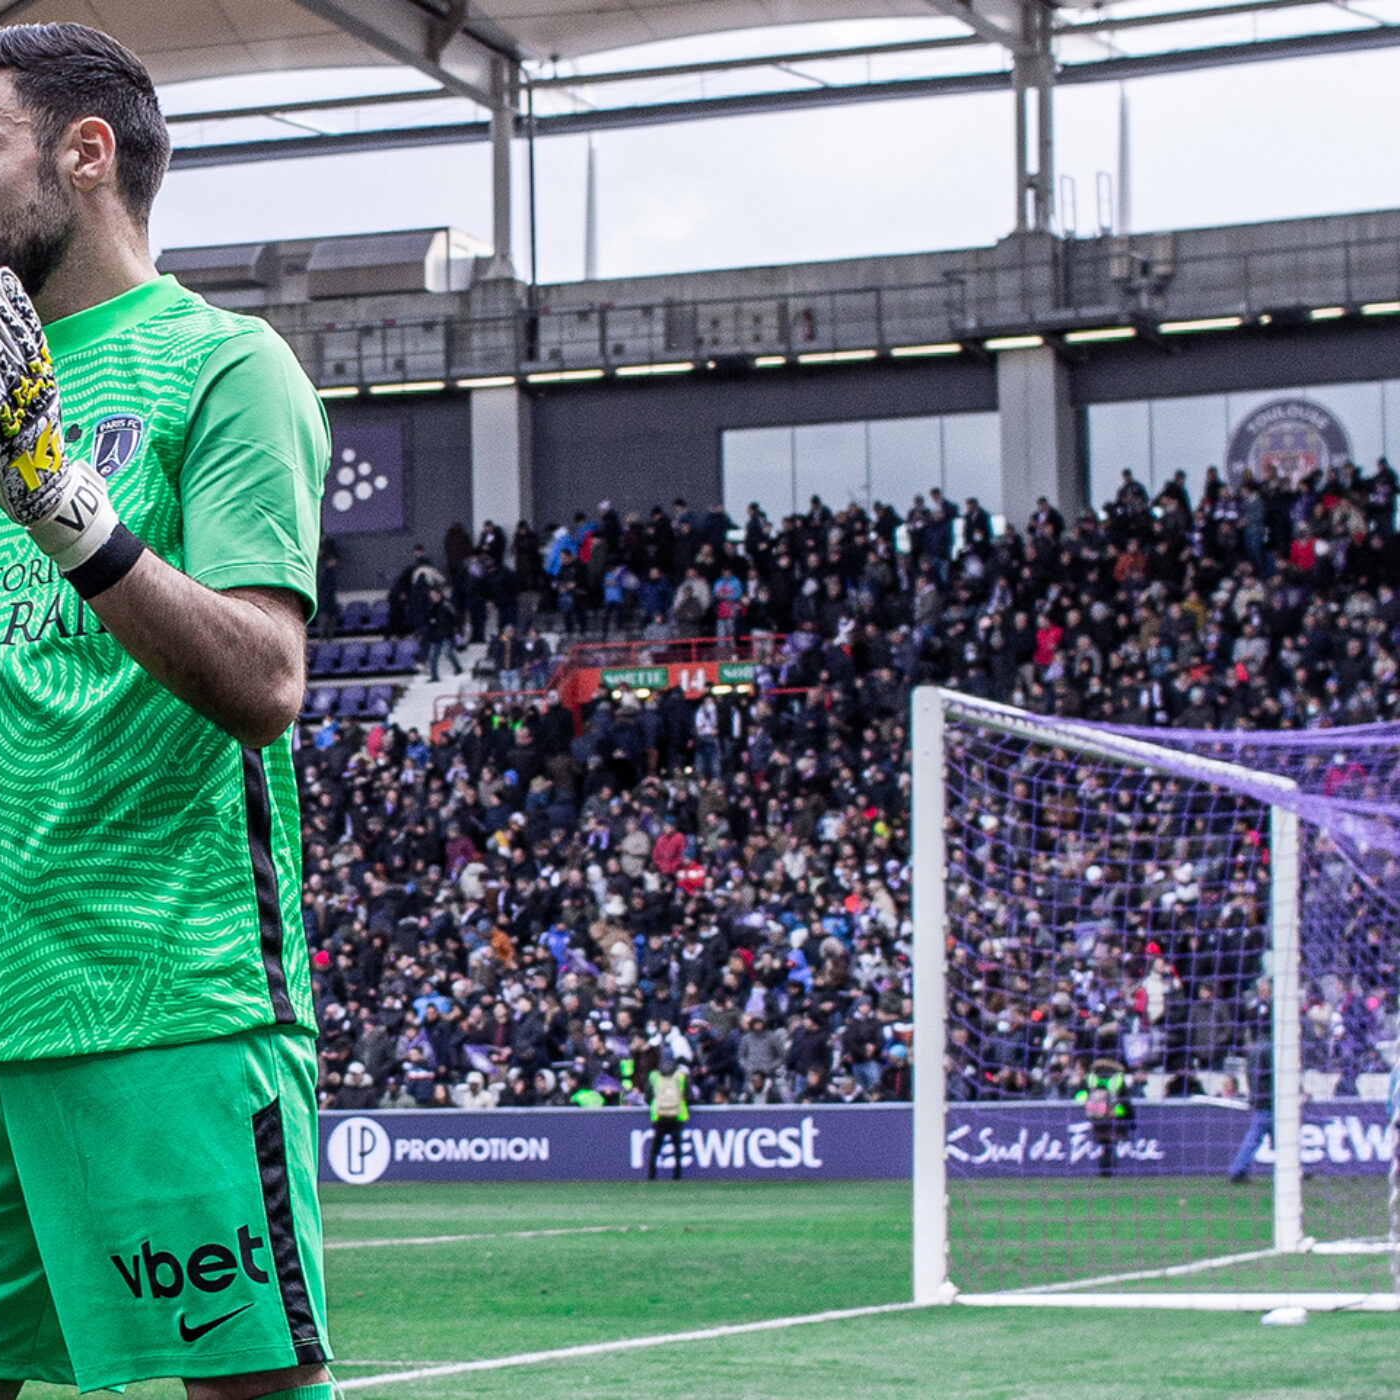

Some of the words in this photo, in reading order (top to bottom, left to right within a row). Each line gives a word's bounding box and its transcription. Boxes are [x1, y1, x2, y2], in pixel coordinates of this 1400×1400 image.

[99, 419, 126, 433] PARIS
[127, 419, 139, 429] FC
[394, 1136, 551, 1164] PROMOTION
[110, 1224, 270, 1300] vbet
